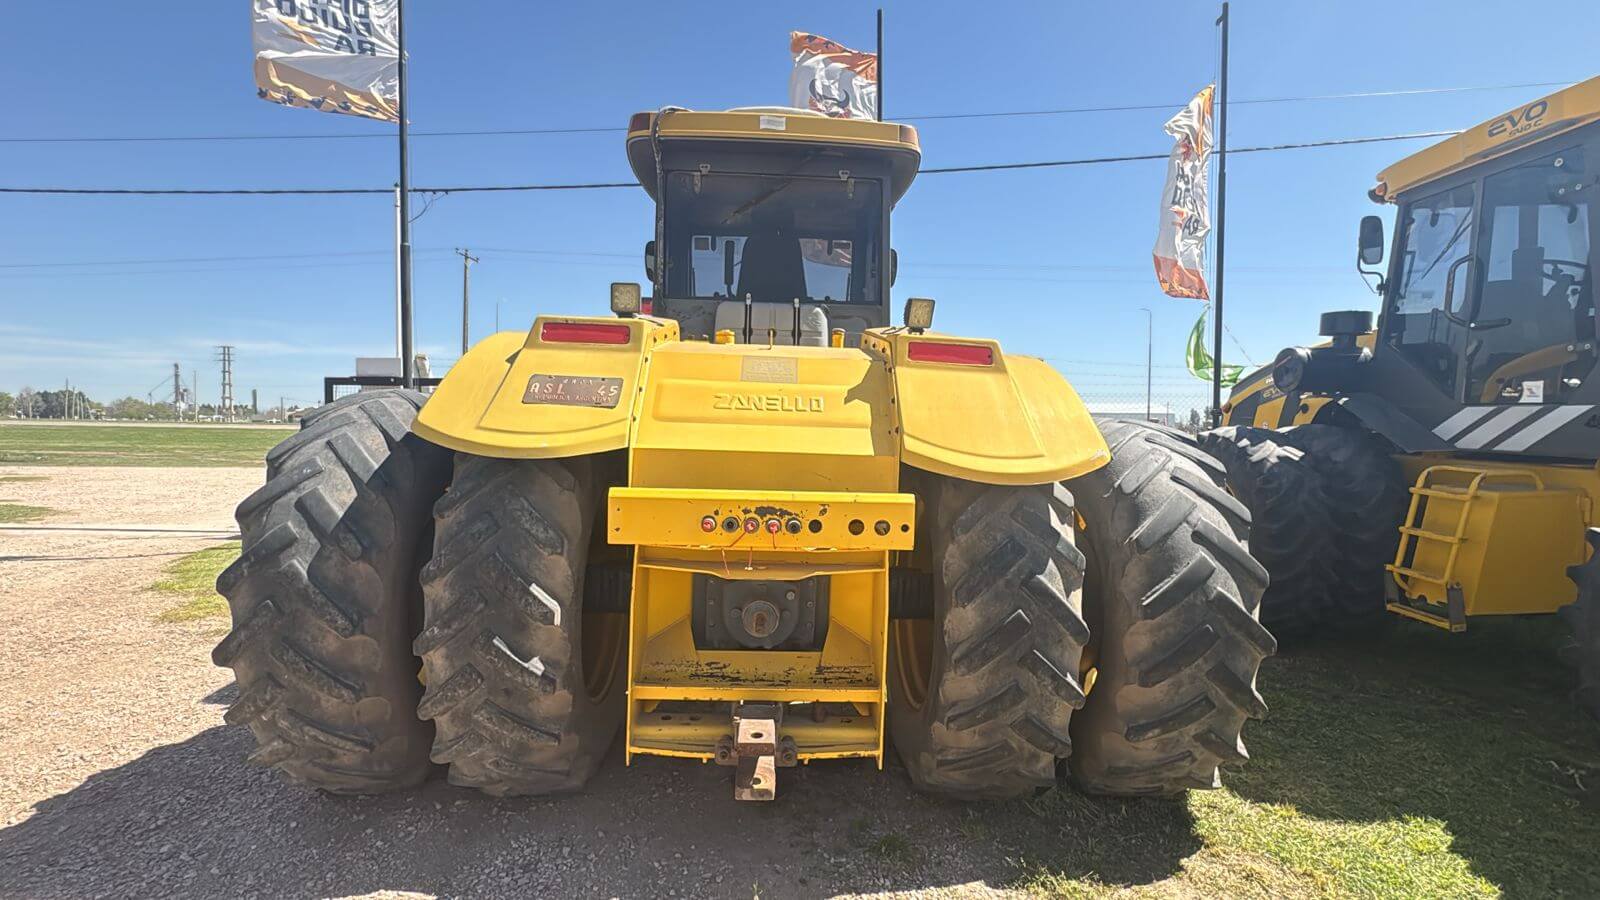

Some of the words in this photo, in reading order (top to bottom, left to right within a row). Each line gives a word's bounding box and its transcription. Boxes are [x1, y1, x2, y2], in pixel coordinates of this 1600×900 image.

[1487, 100, 1548, 137] EVO
[530, 382, 565, 395] ASL
[597, 385, 618, 397] 45
[712, 393, 824, 413] ZANELLO
